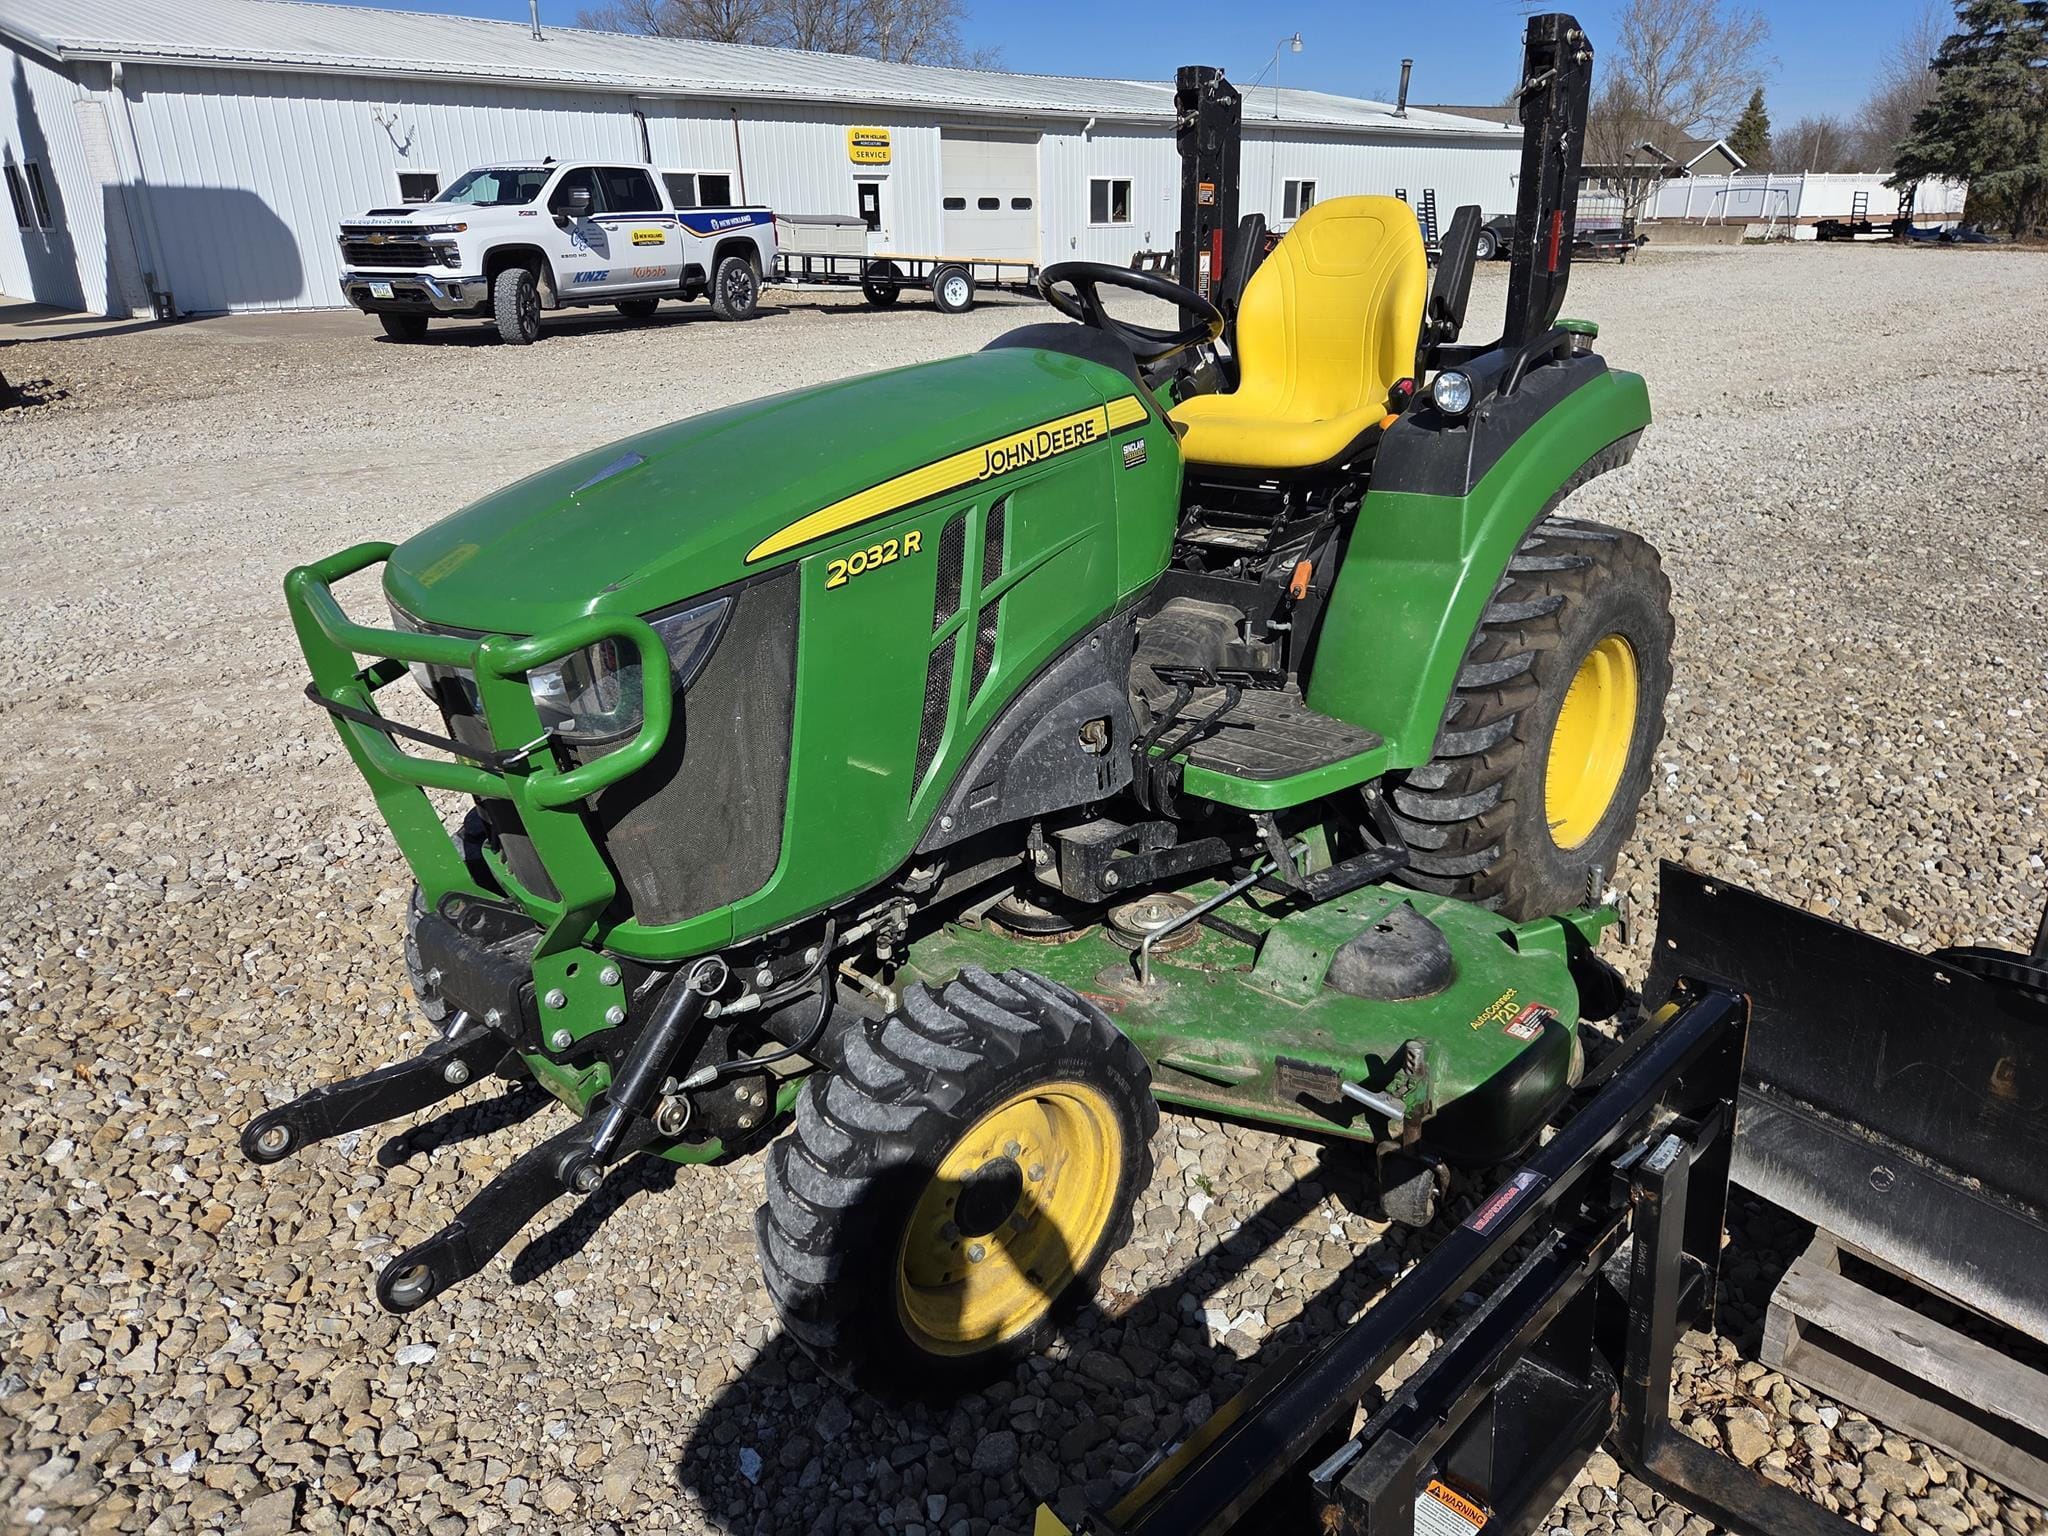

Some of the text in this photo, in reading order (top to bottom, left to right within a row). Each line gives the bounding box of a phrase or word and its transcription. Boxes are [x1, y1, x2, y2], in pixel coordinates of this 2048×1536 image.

[730, 215, 752, 225] HOLLAND
[573, 270, 610, 283] KINZE
[632, 265, 667, 279] Kubota
[979, 419, 1096, 478] JOHN DEERE
[826, 538, 899, 590] 2032
[1469, 988, 1518, 1031] AutoConnect
[1491, 1002, 1521, 1025] 72D
[1441, 1491, 1485, 1525] WARNING
